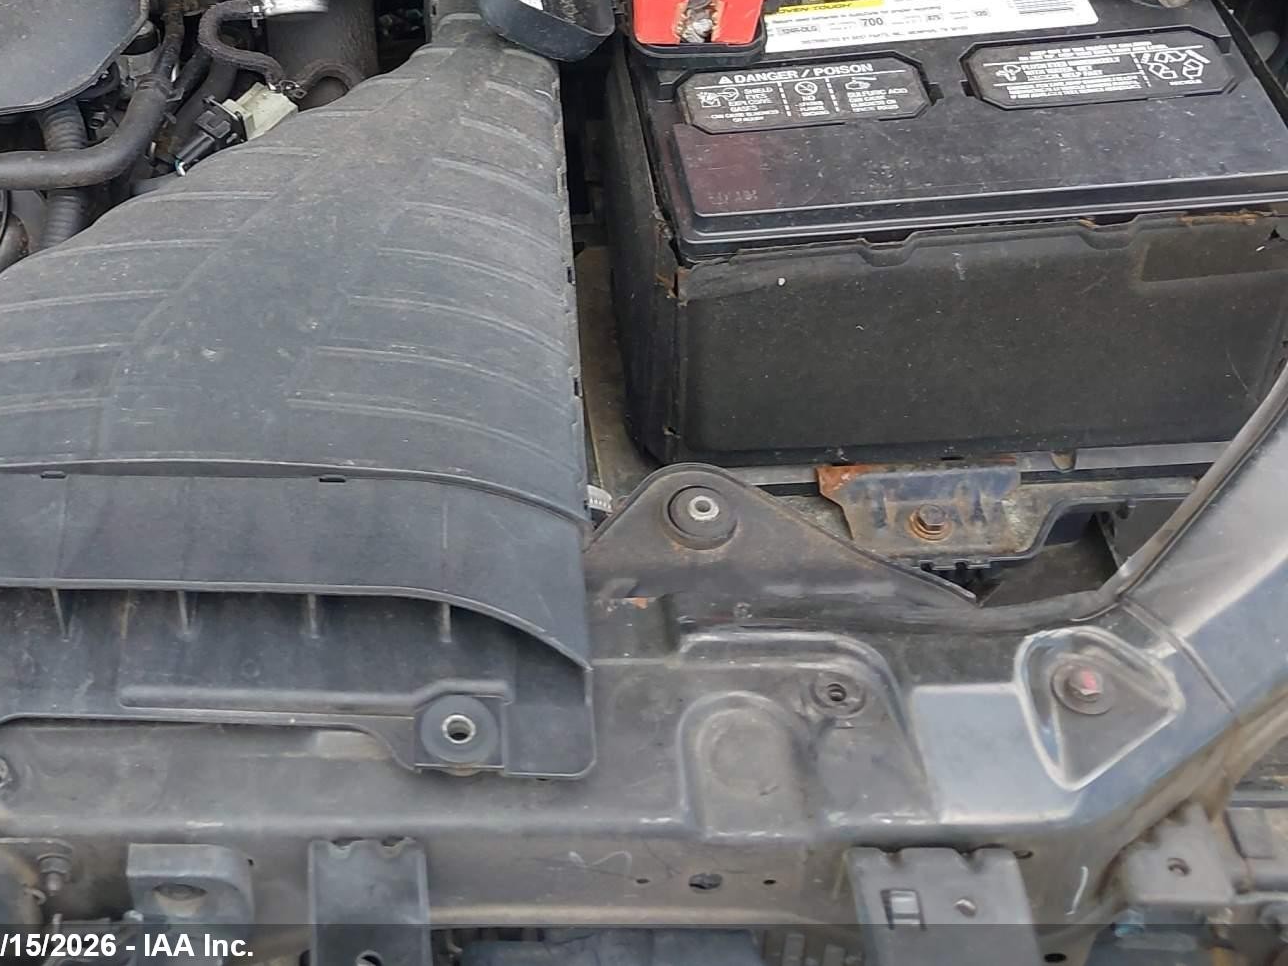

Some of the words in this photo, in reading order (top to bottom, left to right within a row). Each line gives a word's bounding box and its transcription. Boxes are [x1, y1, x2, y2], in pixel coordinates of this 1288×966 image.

[862, 17, 884, 27] 700
[734, 70, 799, 83] DANGER
[813, 63, 874, 76] POISON
